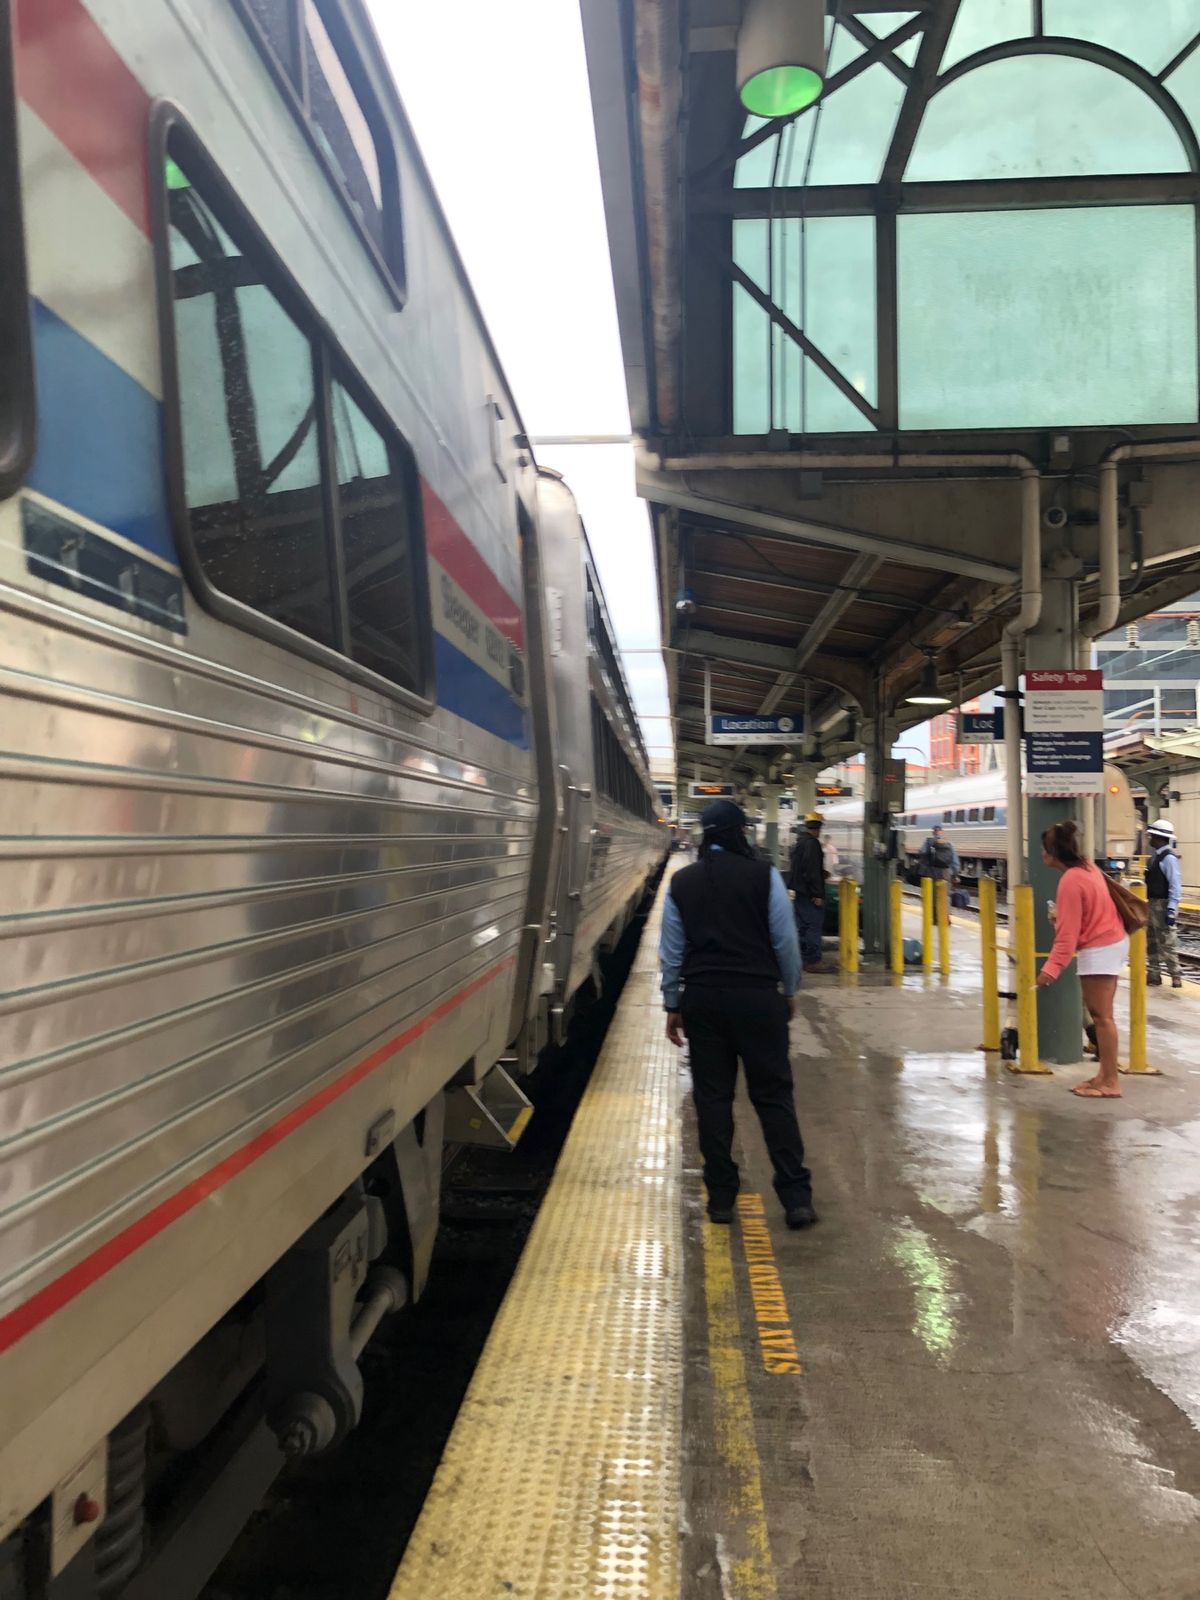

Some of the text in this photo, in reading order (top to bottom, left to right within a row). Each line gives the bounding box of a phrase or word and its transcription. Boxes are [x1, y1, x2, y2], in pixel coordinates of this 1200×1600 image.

[1032, 672, 1088, 684] Safety Tips
[721, 719, 776, 730] Location
[740, 1218, 776, 1263] YELLOW
[748, 1264, 790, 1322] BEHIND
[758, 1327, 803, 1376] STAY
